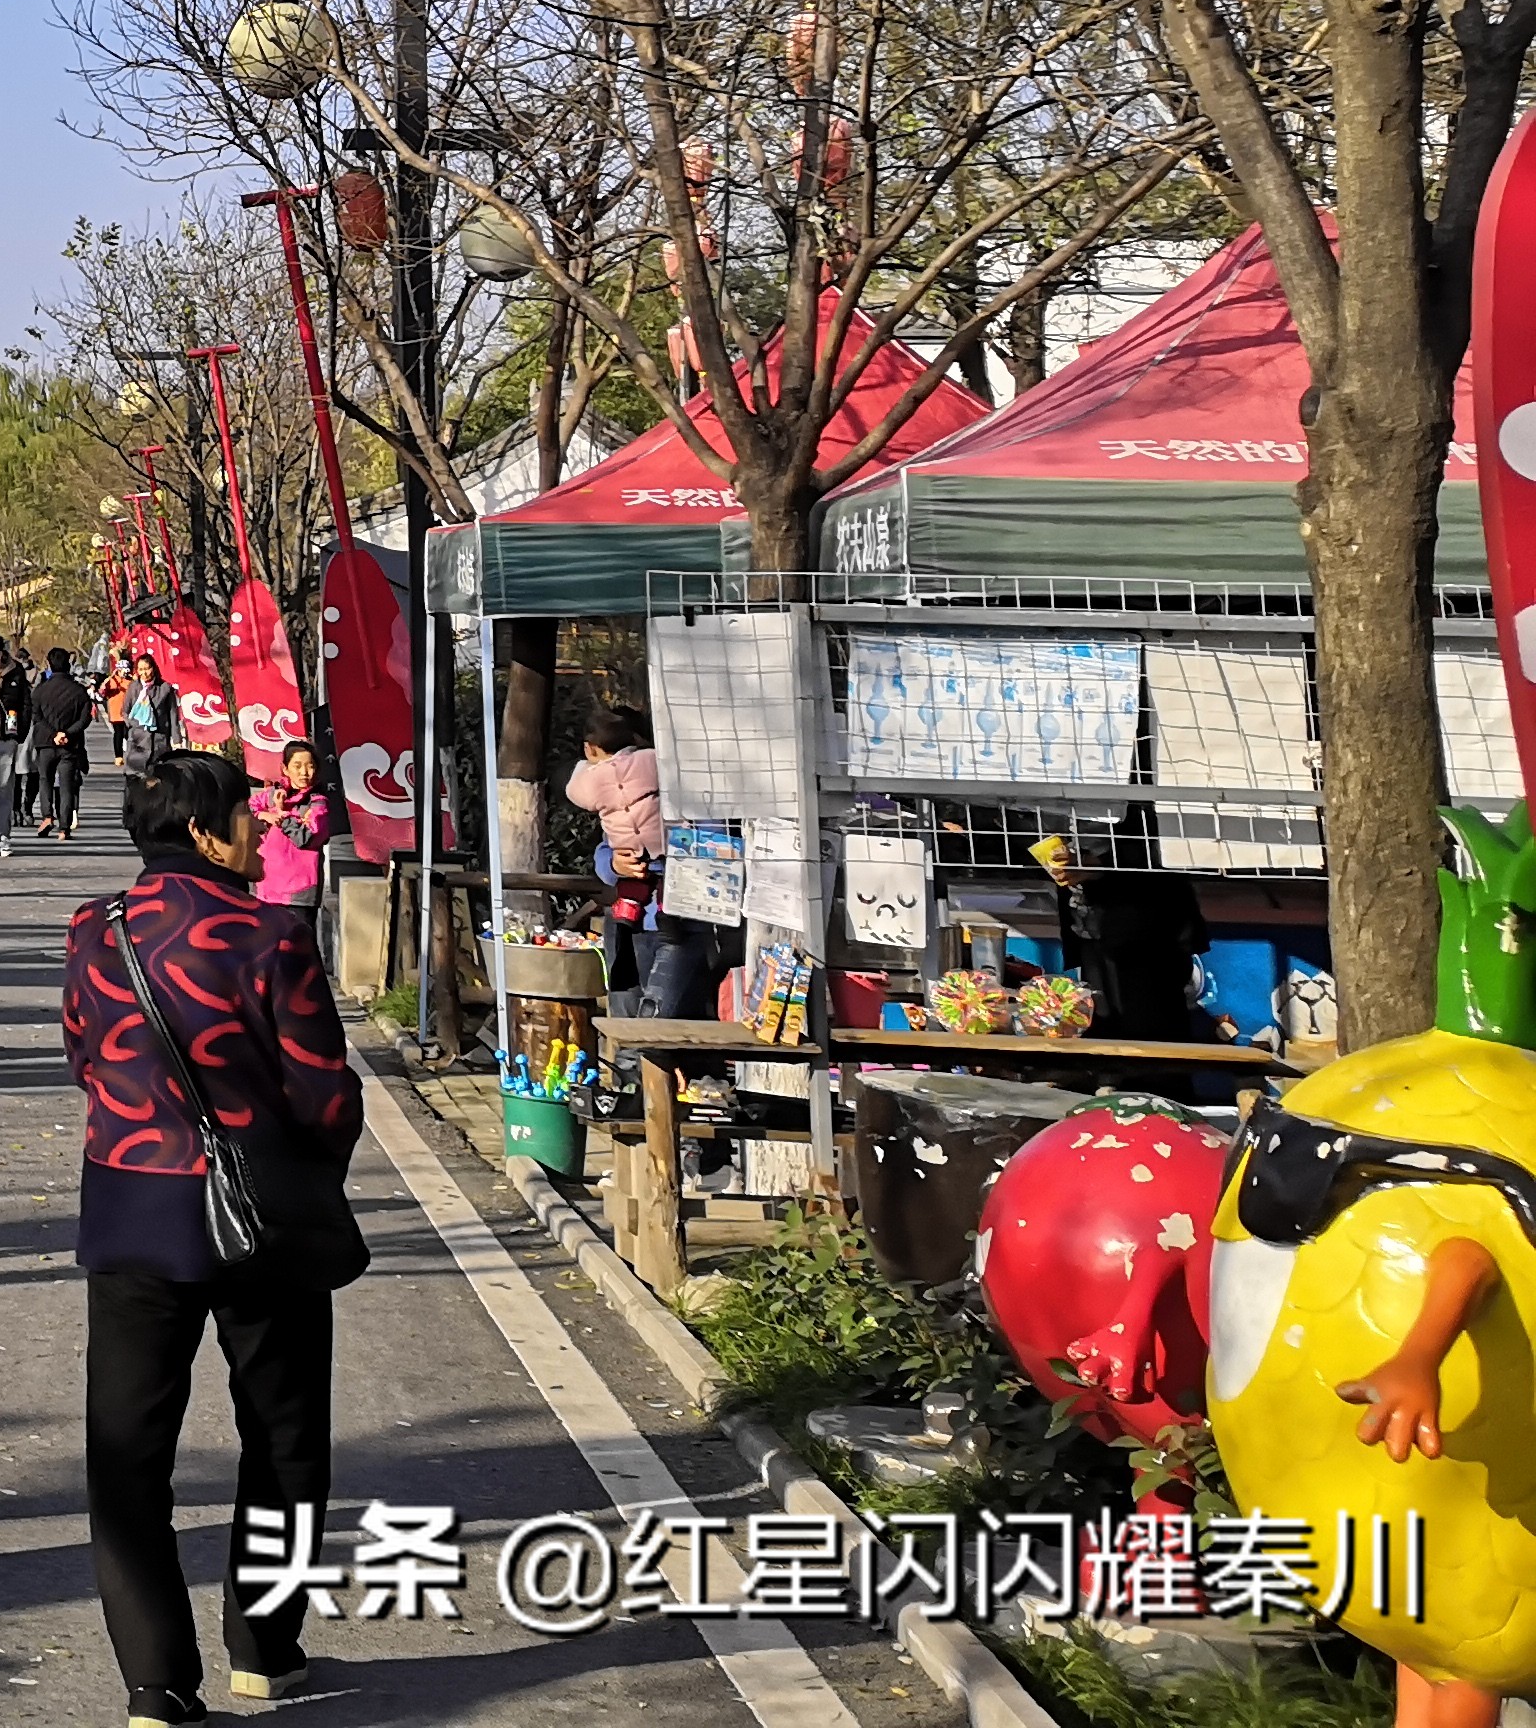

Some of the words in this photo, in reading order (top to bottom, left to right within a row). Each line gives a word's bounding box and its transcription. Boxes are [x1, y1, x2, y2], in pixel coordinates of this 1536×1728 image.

[1098, 439, 1309, 463] 天然的
[836, 504, 890, 573] 农夫山泉
